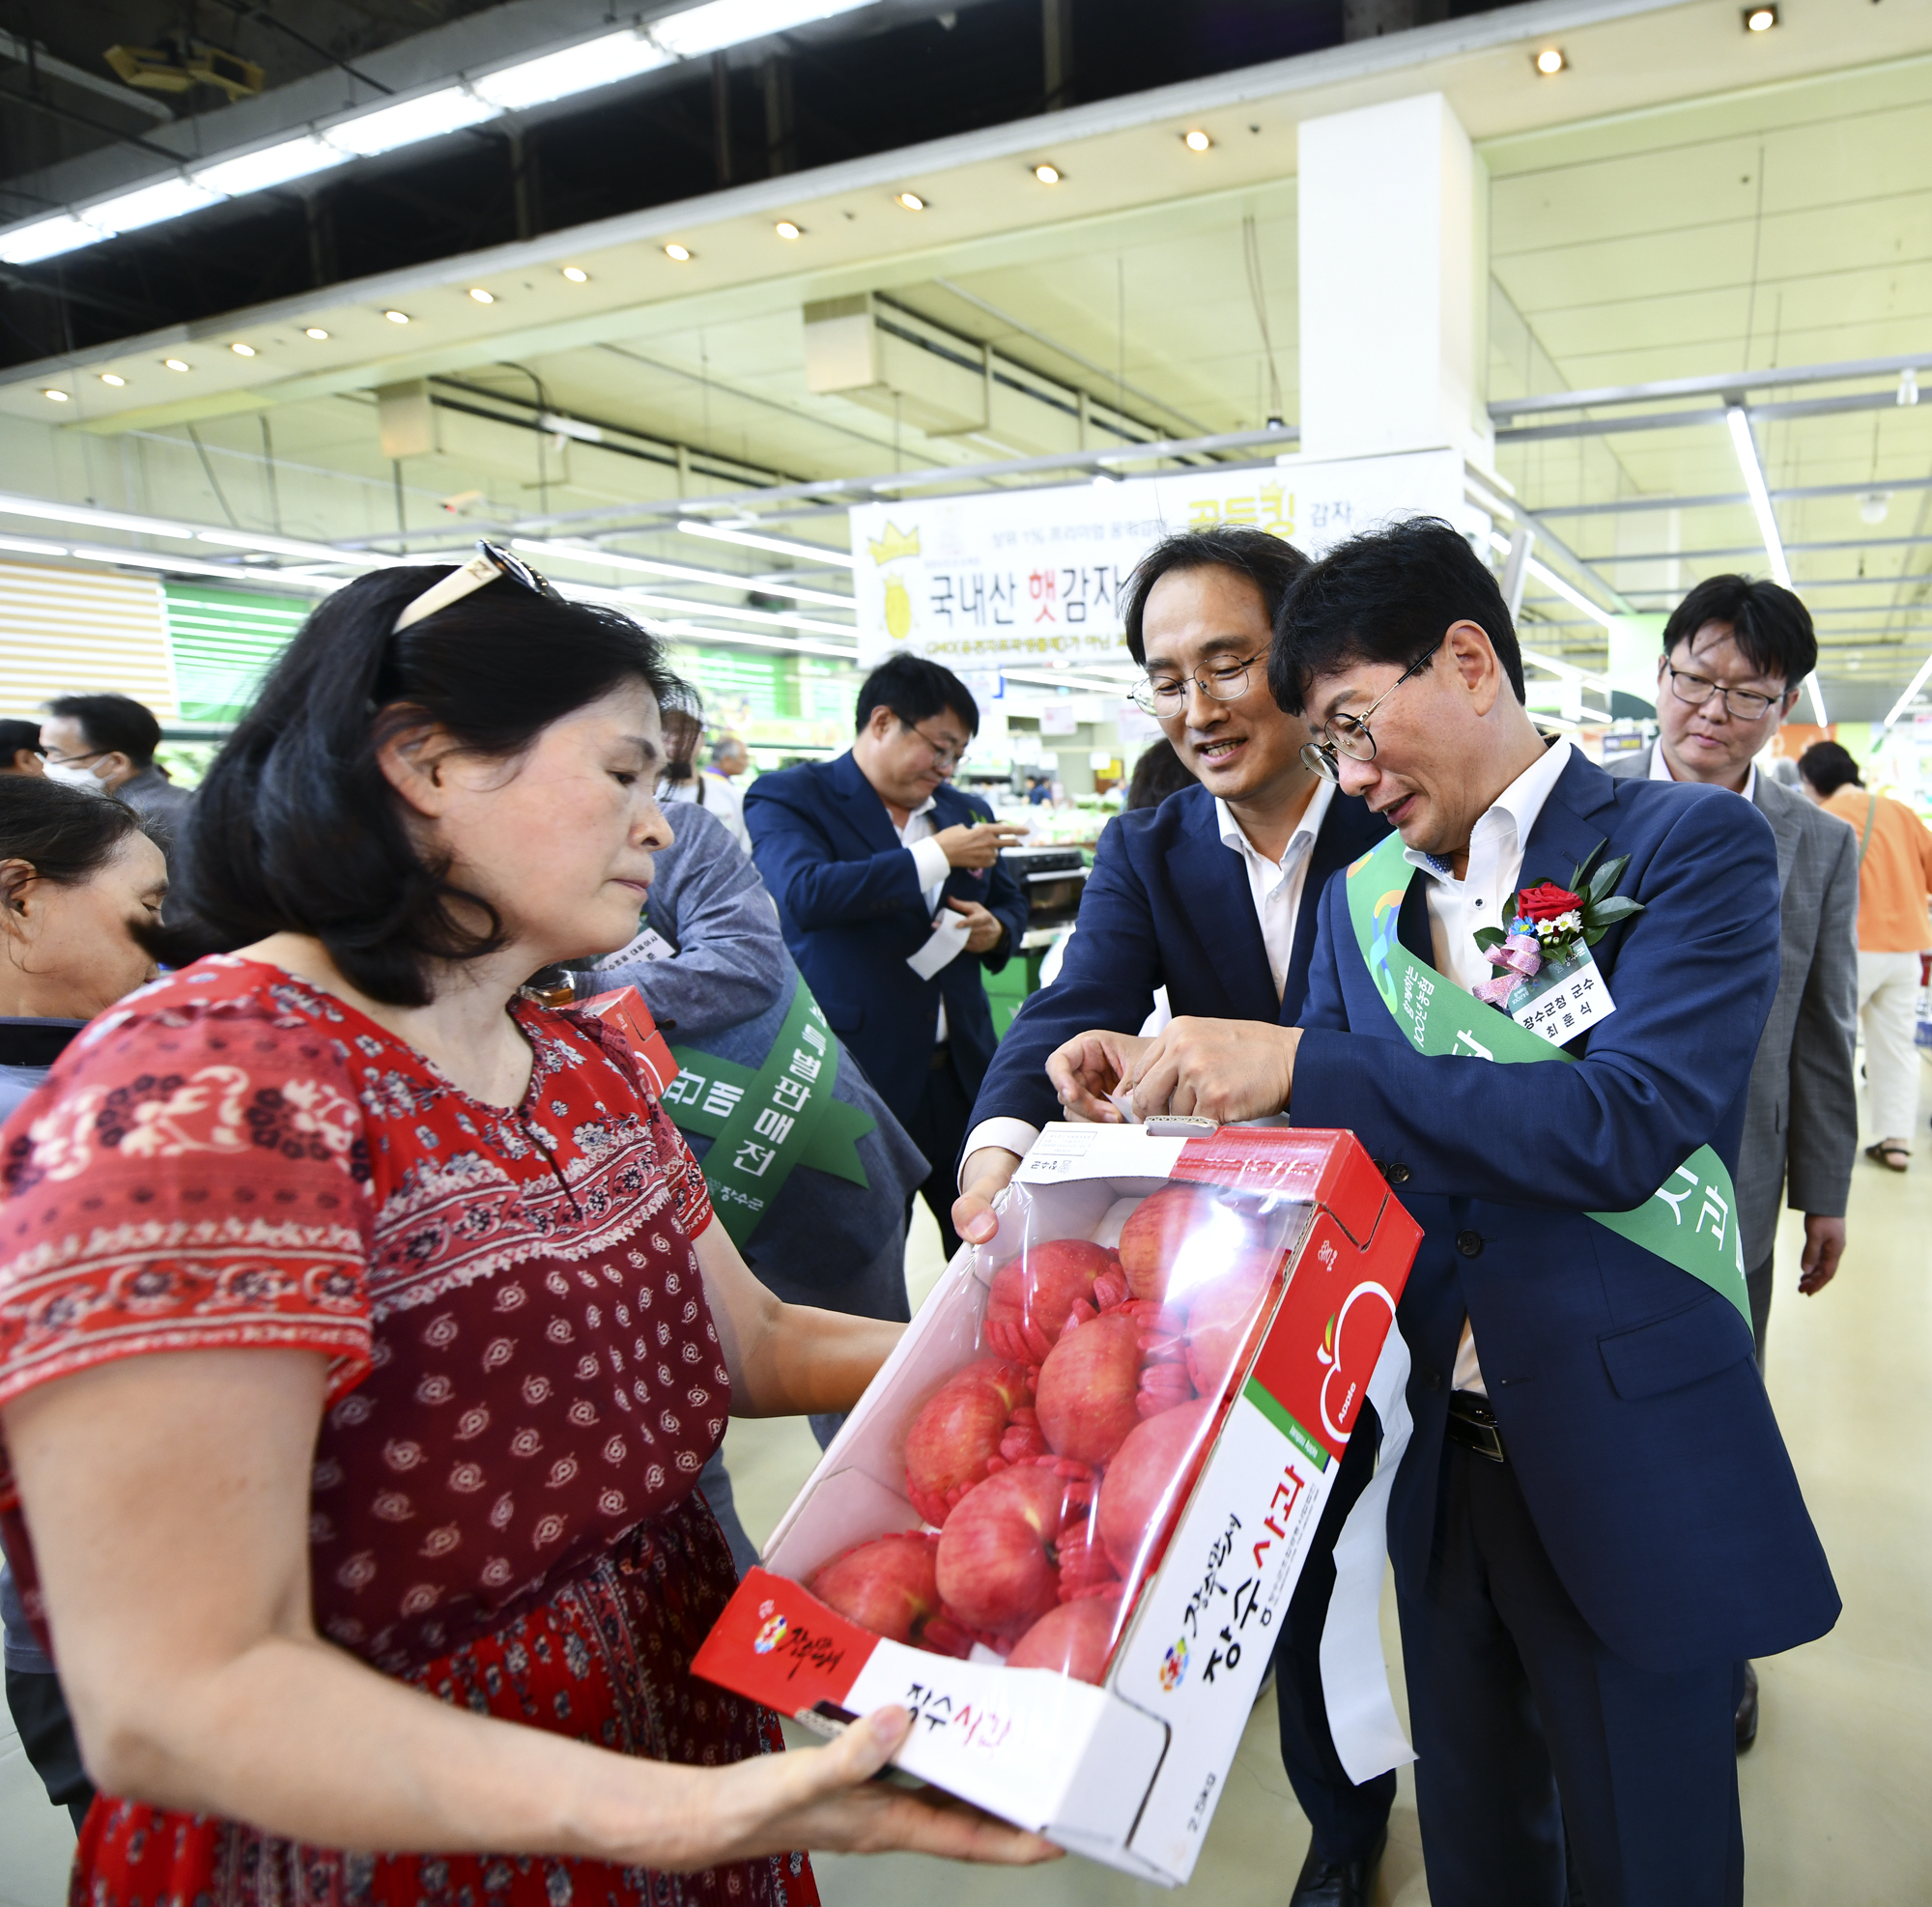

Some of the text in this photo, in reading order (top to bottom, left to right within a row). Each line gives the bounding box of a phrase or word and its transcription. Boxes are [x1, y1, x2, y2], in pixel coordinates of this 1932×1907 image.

[1310, 501, 1352, 527] 감자
[930, 564, 1125, 627] 국내산 햇감자
[1402, 965, 1419, 1020] 함께하는
[1521, 977, 1596, 1031] 장수군청 군수
[720, 1185, 764, 1211] 장수군
[1338, 1380, 1357, 1425] Apple
